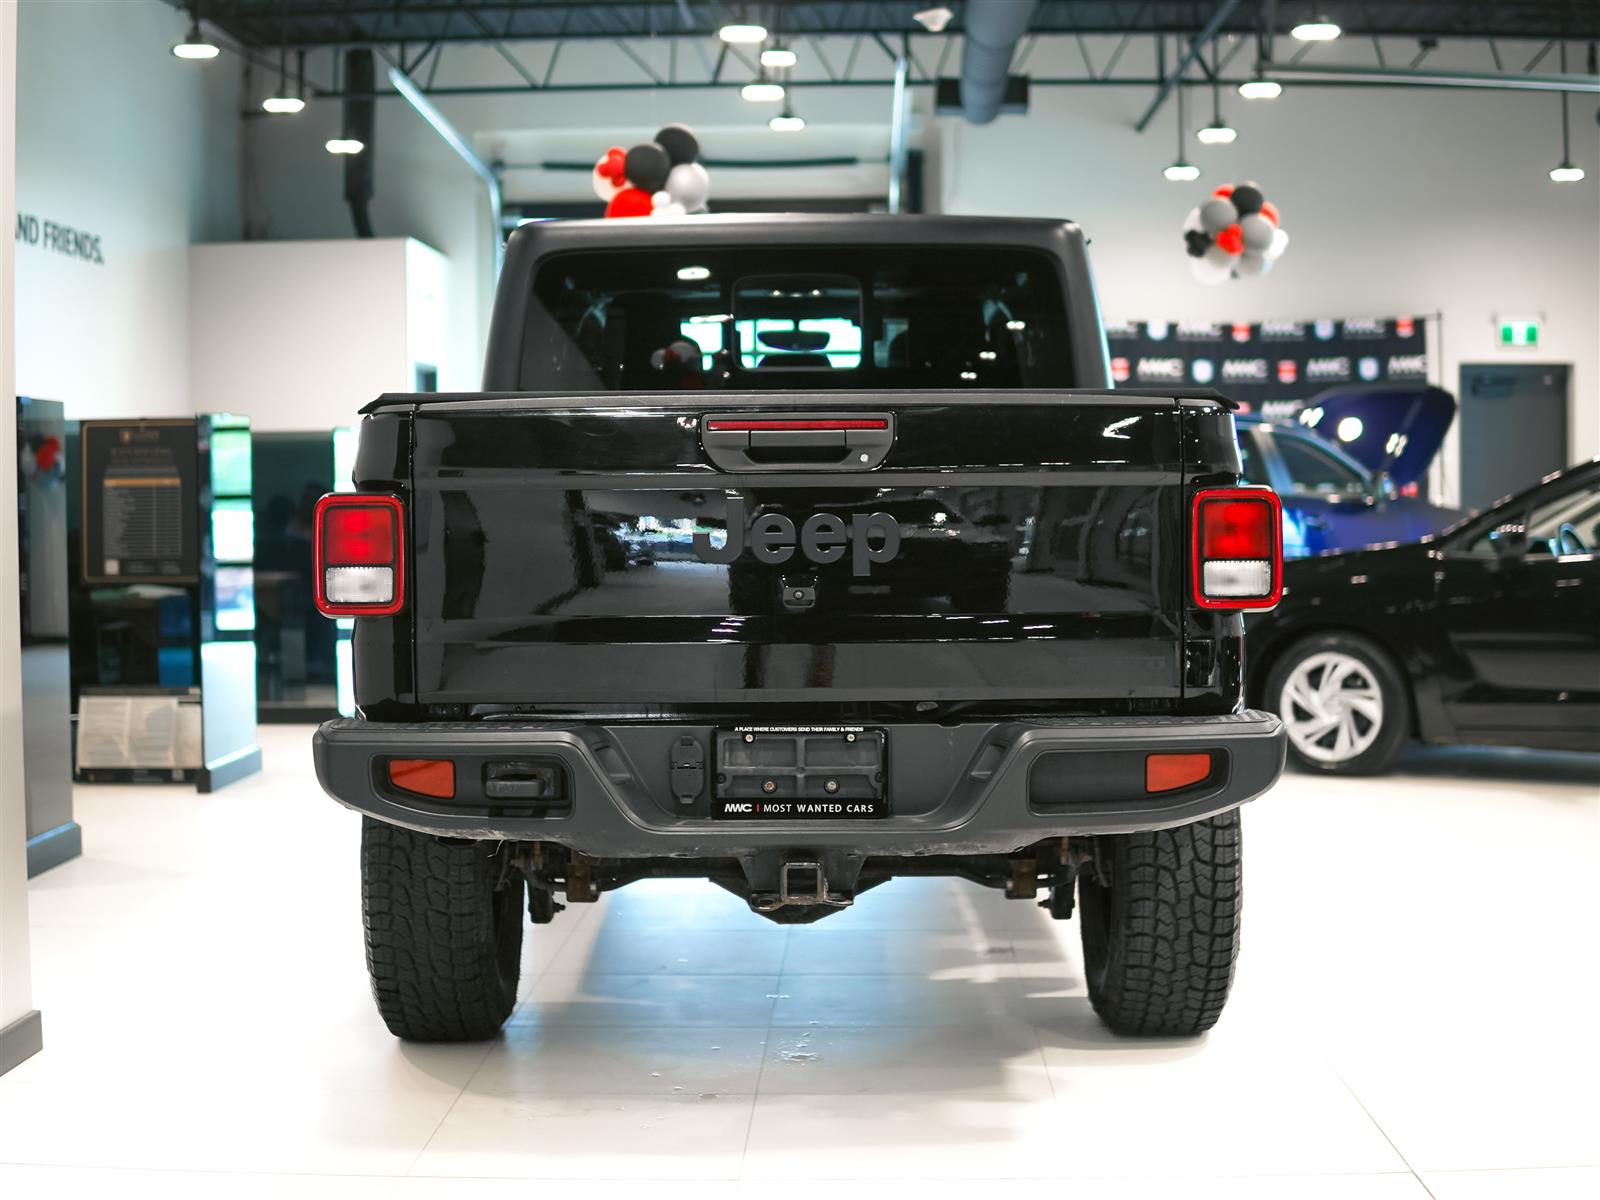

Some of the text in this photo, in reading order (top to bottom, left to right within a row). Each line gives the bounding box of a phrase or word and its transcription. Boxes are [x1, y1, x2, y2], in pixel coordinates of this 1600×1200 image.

[692, 496, 901, 577] Jeep
[763, 803, 874, 813] MOST WANTED CARS
